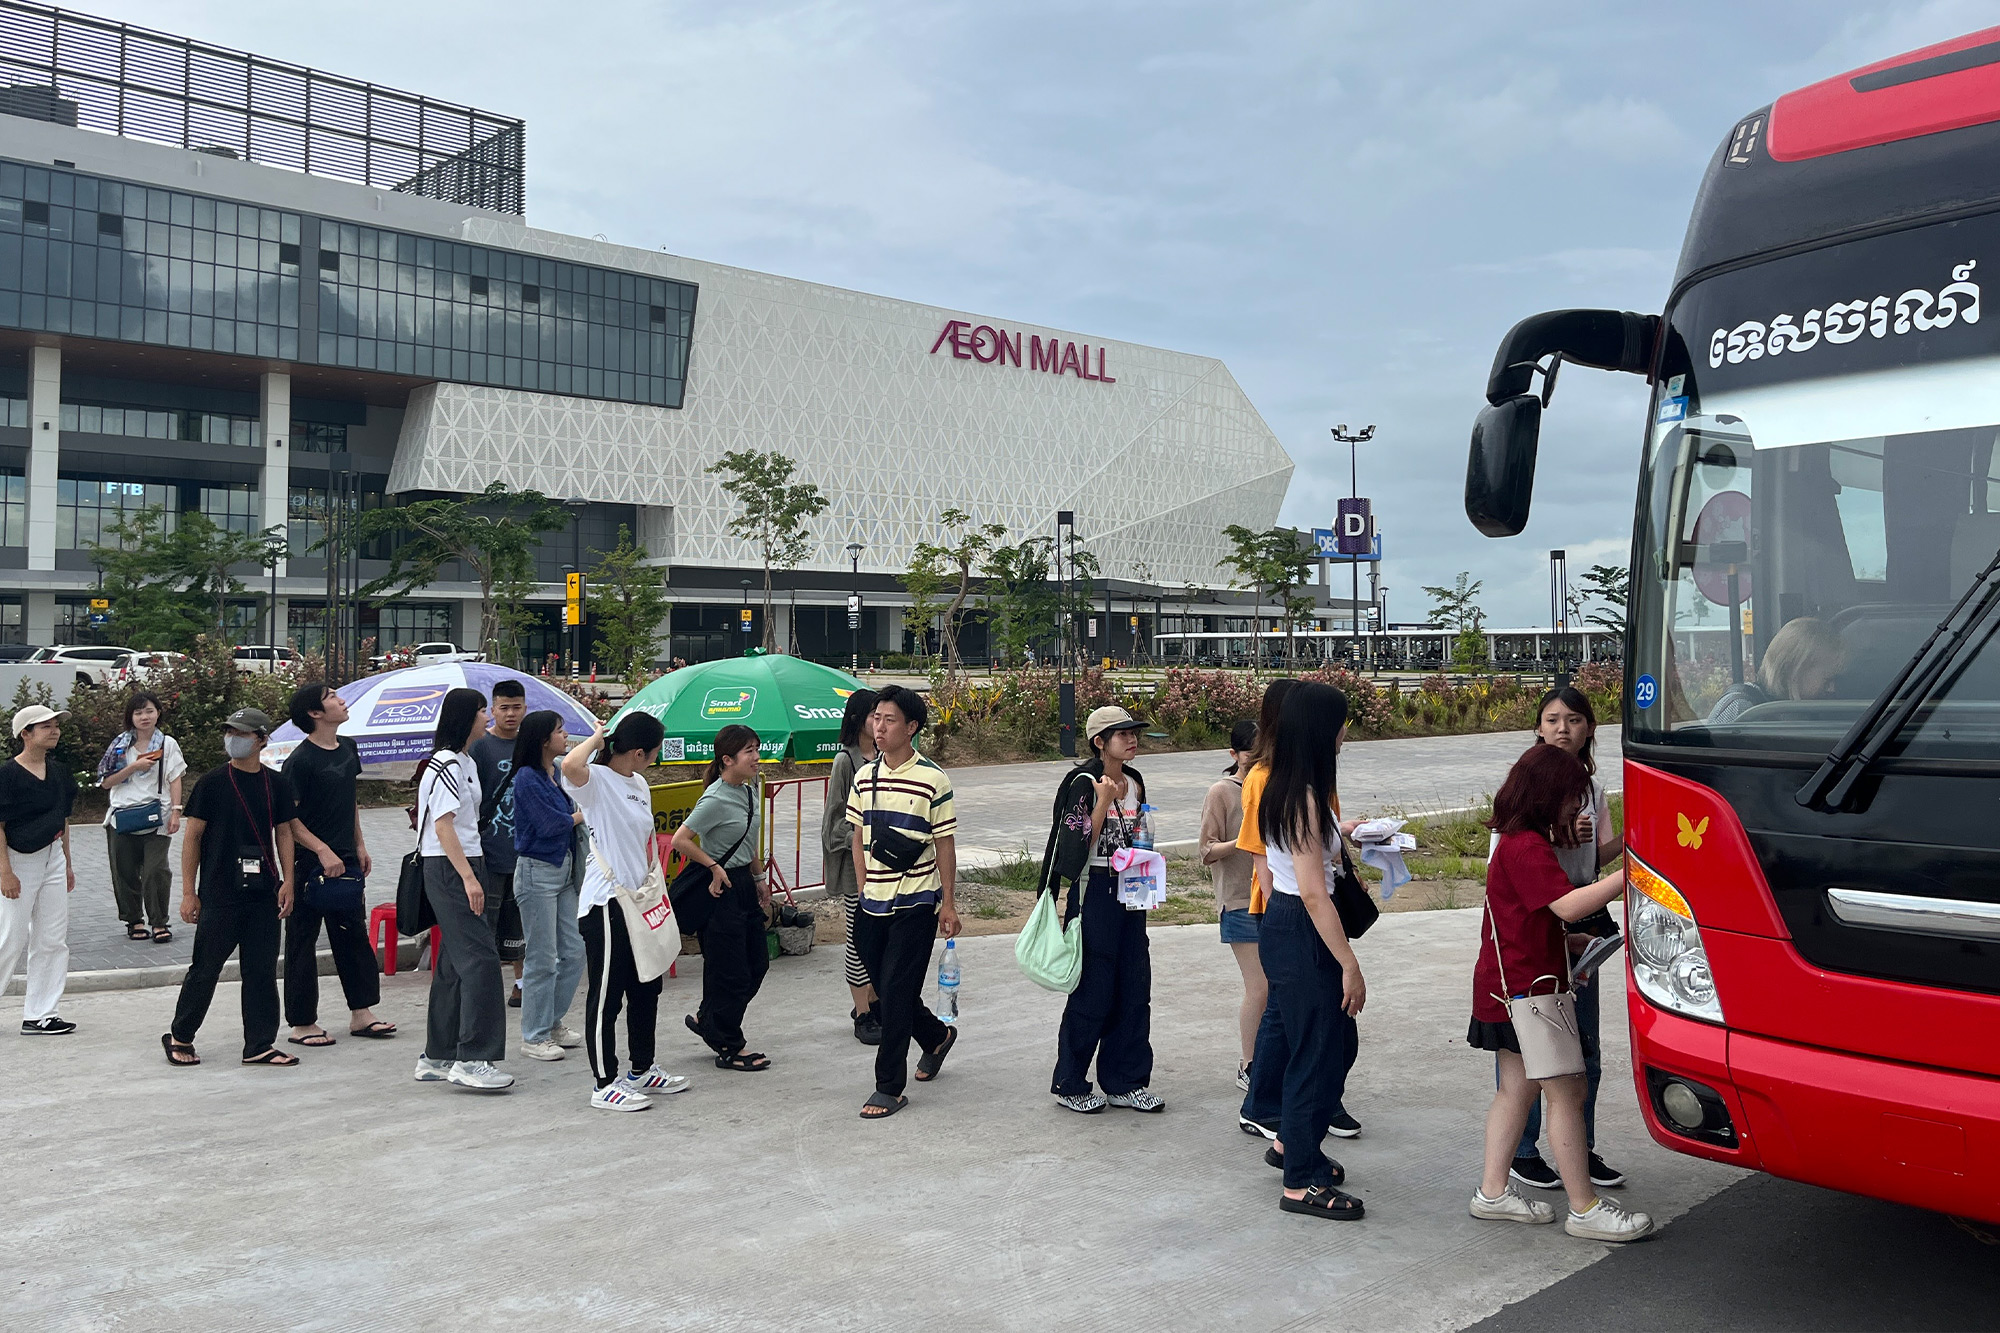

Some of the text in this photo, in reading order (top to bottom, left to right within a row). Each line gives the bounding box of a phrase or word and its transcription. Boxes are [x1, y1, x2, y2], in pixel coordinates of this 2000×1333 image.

[1031, 335, 1116, 383] MALL
[1344, 513, 1365, 537] D
[1636, 682, 1655, 701] 29
[710, 699, 742, 707] Smart
[362, 749, 397, 757] SPECIALIZED
